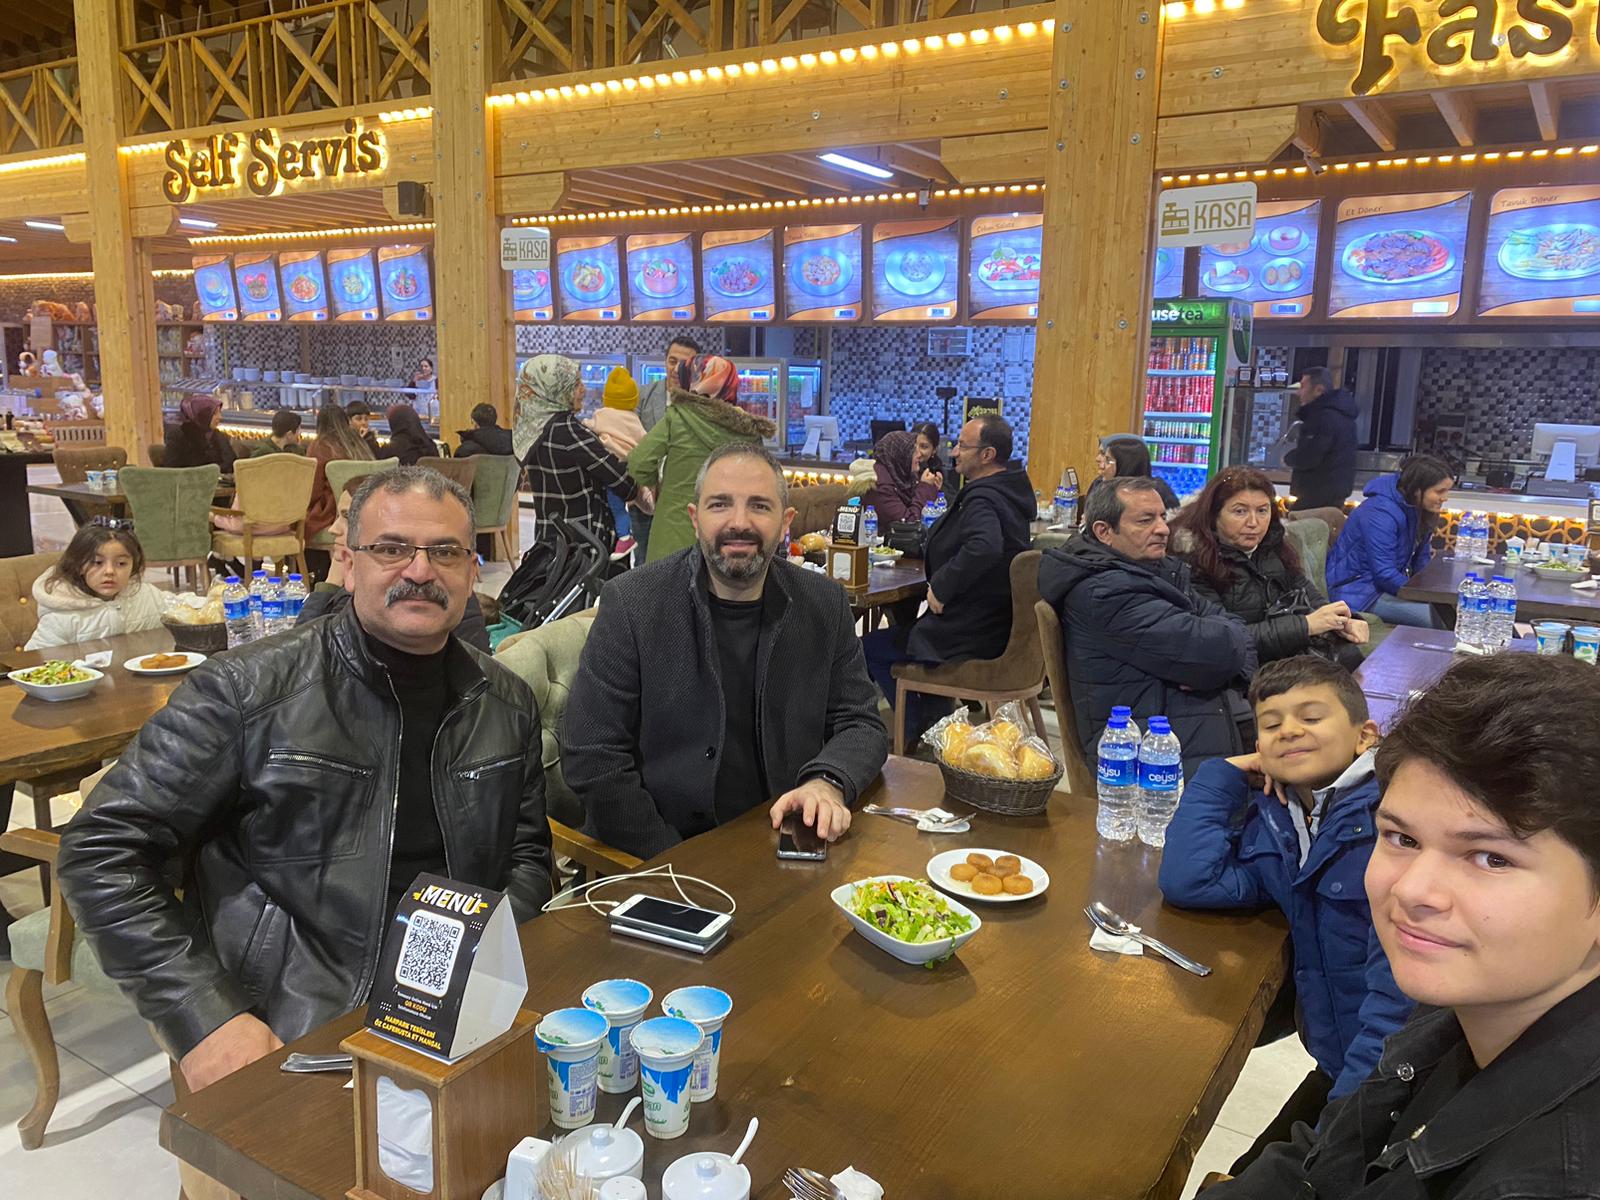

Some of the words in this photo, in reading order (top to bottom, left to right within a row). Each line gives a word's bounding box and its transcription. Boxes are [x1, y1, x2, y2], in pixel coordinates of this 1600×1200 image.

[1316, 0, 1600, 96] Fas
[163, 133, 239, 202] Self
[247, 118, 383, 197] Servis
[1194, 200, 1251, 230] KASA
[519, 240, 548, 259] KASA
[420, 885, 482, 916] MENÜ
